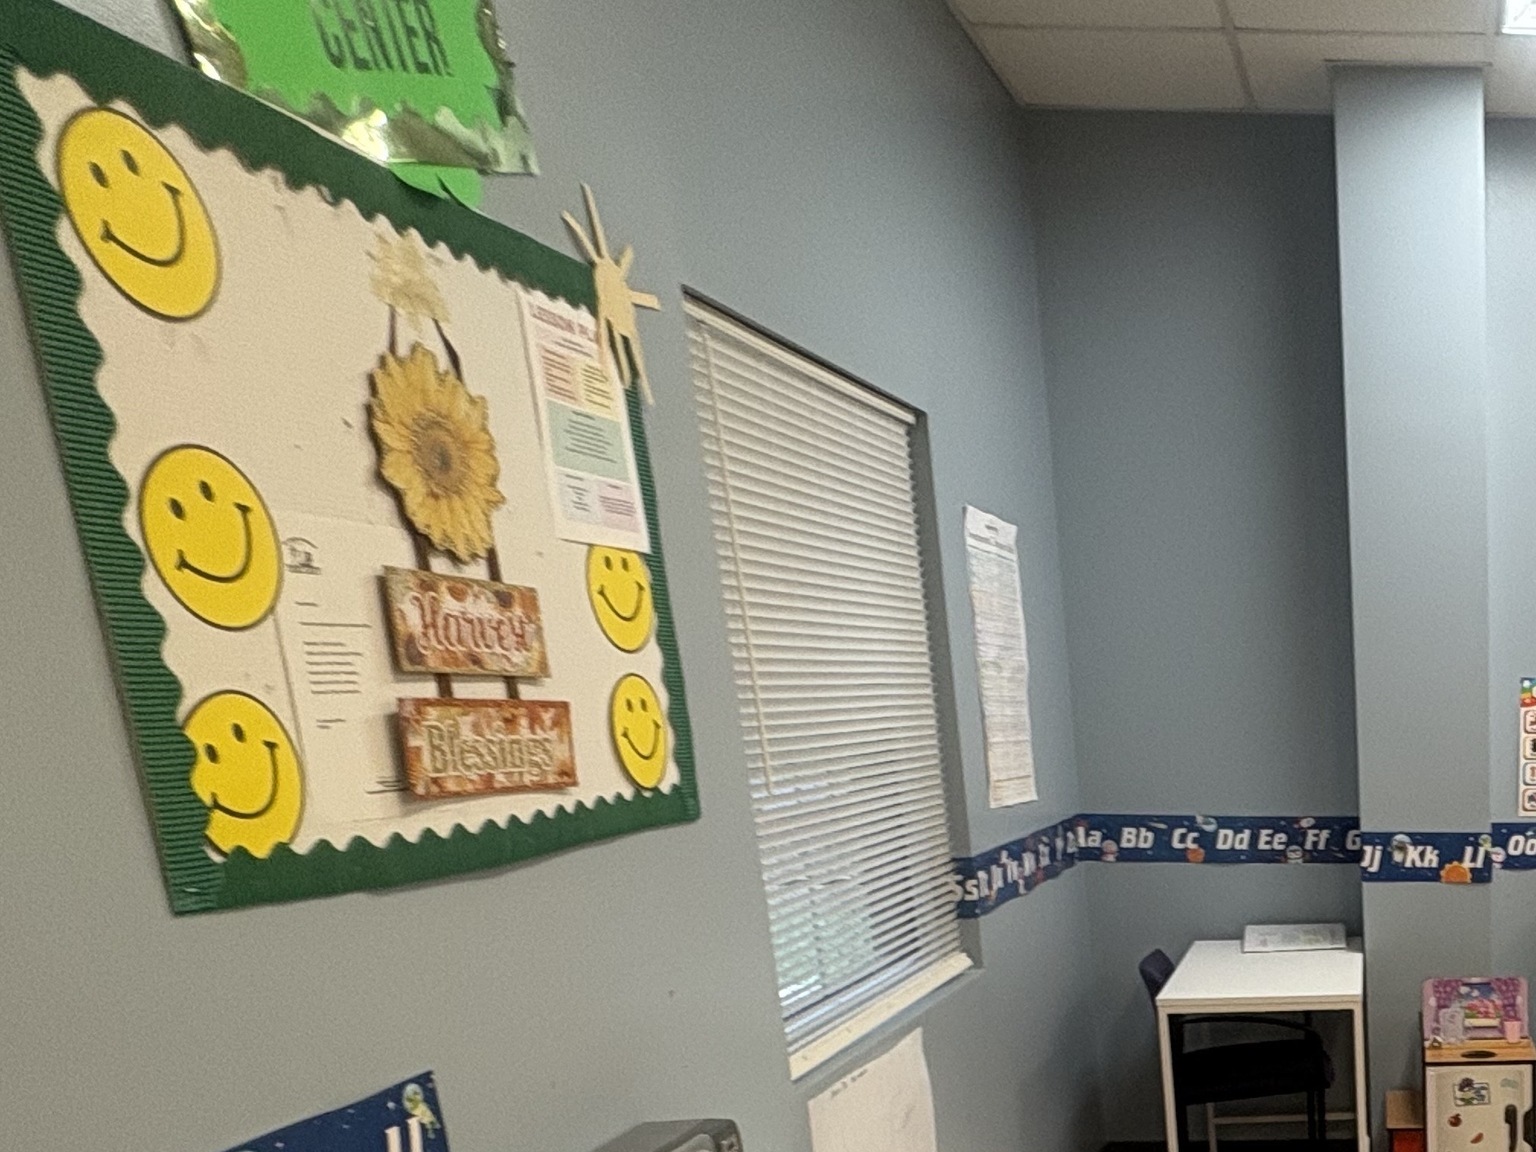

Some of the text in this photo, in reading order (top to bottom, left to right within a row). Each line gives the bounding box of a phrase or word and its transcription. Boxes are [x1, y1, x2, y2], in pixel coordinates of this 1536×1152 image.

[1120, 827, 1154, 848] Bb
[1171, 828, 1199, 849] Cc
[1216, 829, 1250, 850] Dd
[1257, 829, 1287, 850] Ee
[1305, 829, 1329, 850] Ff
[1404, 845, 1439, 868] Kk
